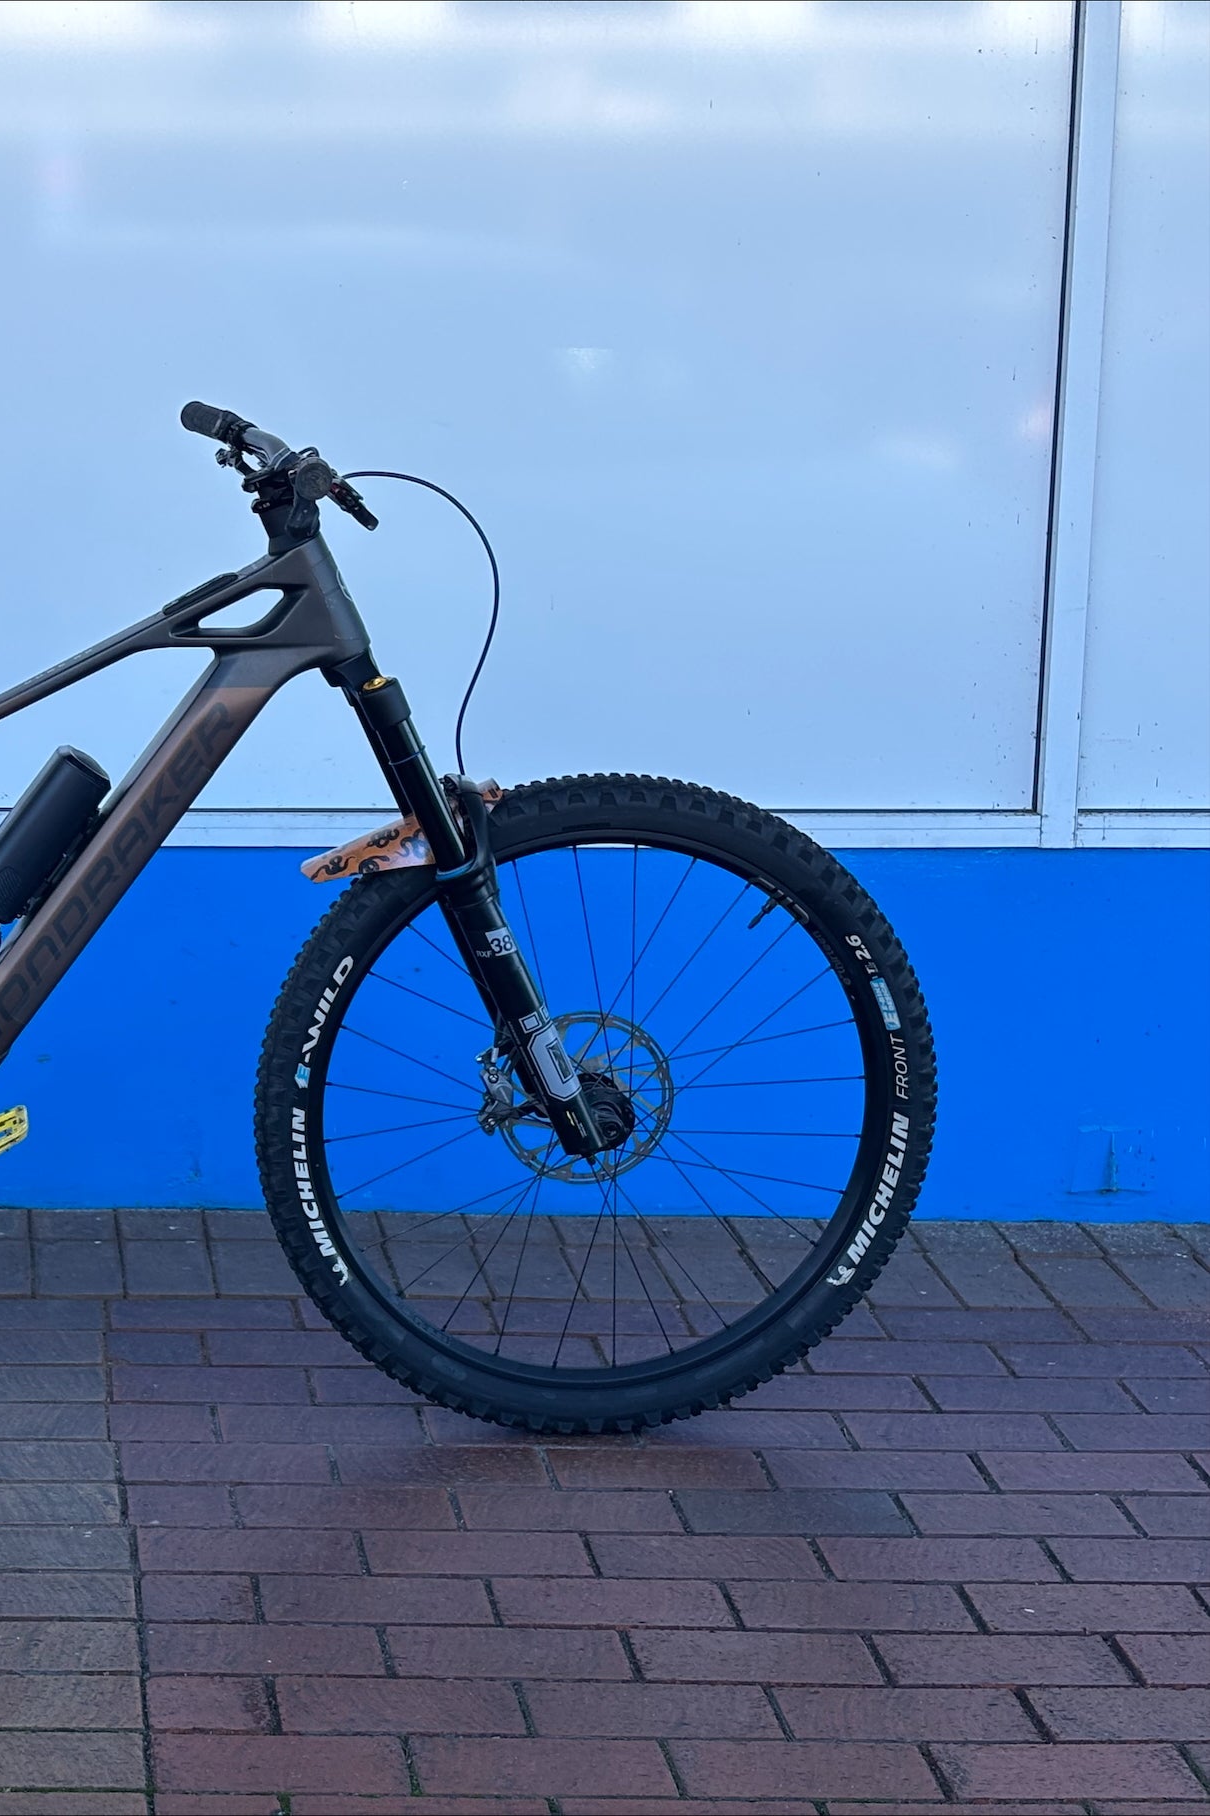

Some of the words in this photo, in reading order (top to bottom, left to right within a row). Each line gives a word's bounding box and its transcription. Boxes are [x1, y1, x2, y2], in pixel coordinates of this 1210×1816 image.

[490, 934, 514, 953] 38
[844, 934, 872, 961] 2.6
[294, 955, 355, 1089] E-WILD
[292, 1106, 338, 1257] MICHELIN
[847, 1111, 910, 1265] MICHELIN
[889, 1033, 909, 1100] FRONT
